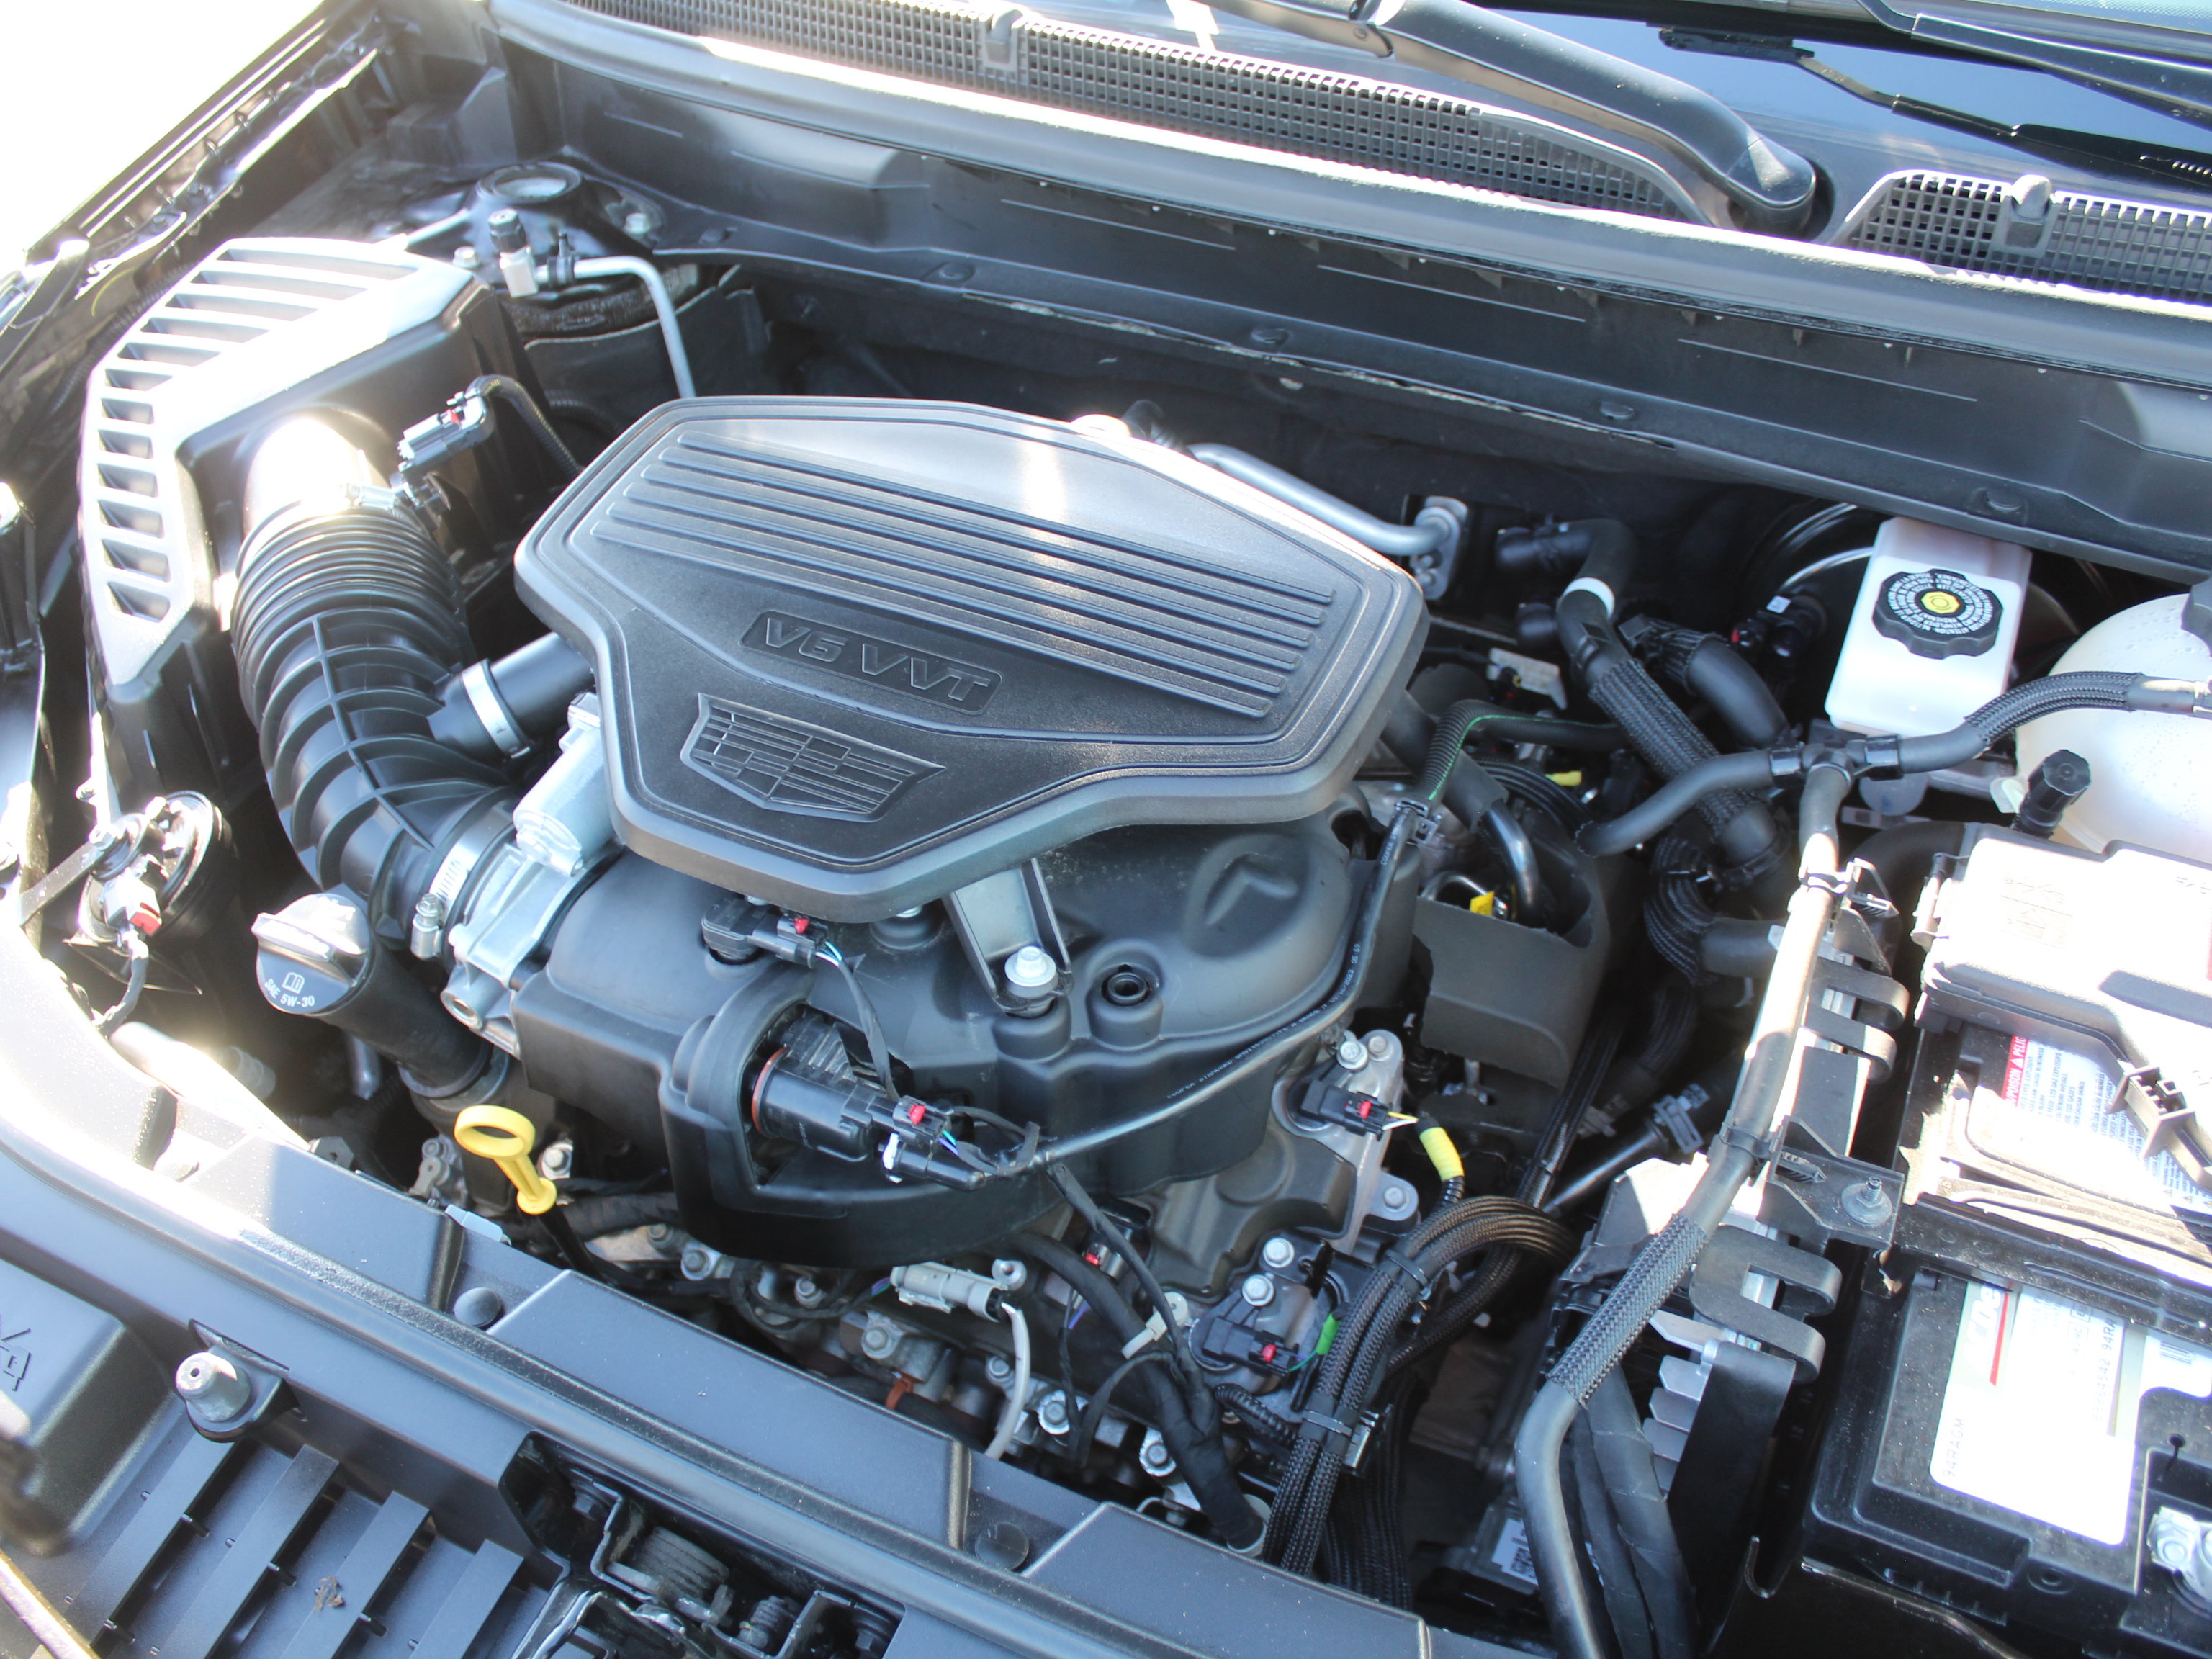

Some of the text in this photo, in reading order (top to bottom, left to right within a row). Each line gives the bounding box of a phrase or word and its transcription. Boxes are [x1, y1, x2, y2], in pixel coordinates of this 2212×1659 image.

[765, 617, 991, 701] V6 VVT
[264, 979, 315, 1007] SAE 5W-30
[1943, 1417, 1965, 1478] 94RAGM
